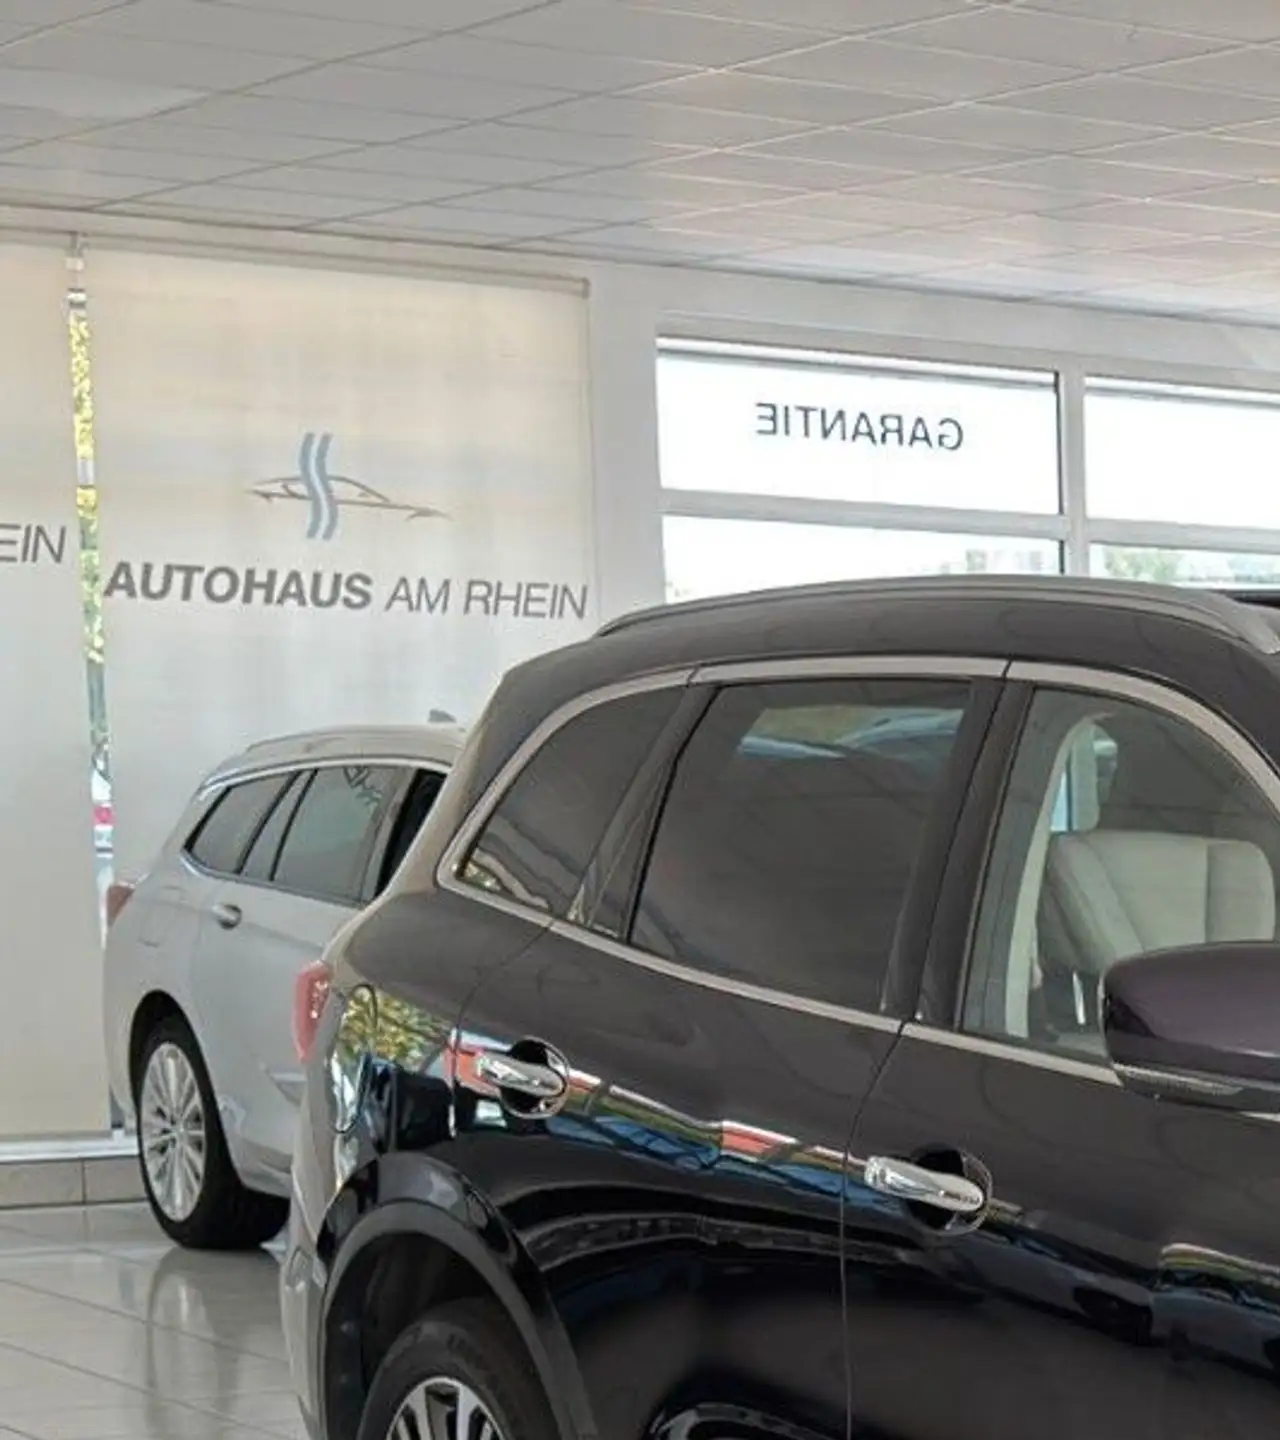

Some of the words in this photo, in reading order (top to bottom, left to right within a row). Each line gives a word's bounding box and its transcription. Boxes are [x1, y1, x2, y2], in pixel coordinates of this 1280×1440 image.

[103, 560, 372, 610] AUTOHAUS
[385, 577, 450, 614] AM
[464, 580, 588, 619] RHEIN
